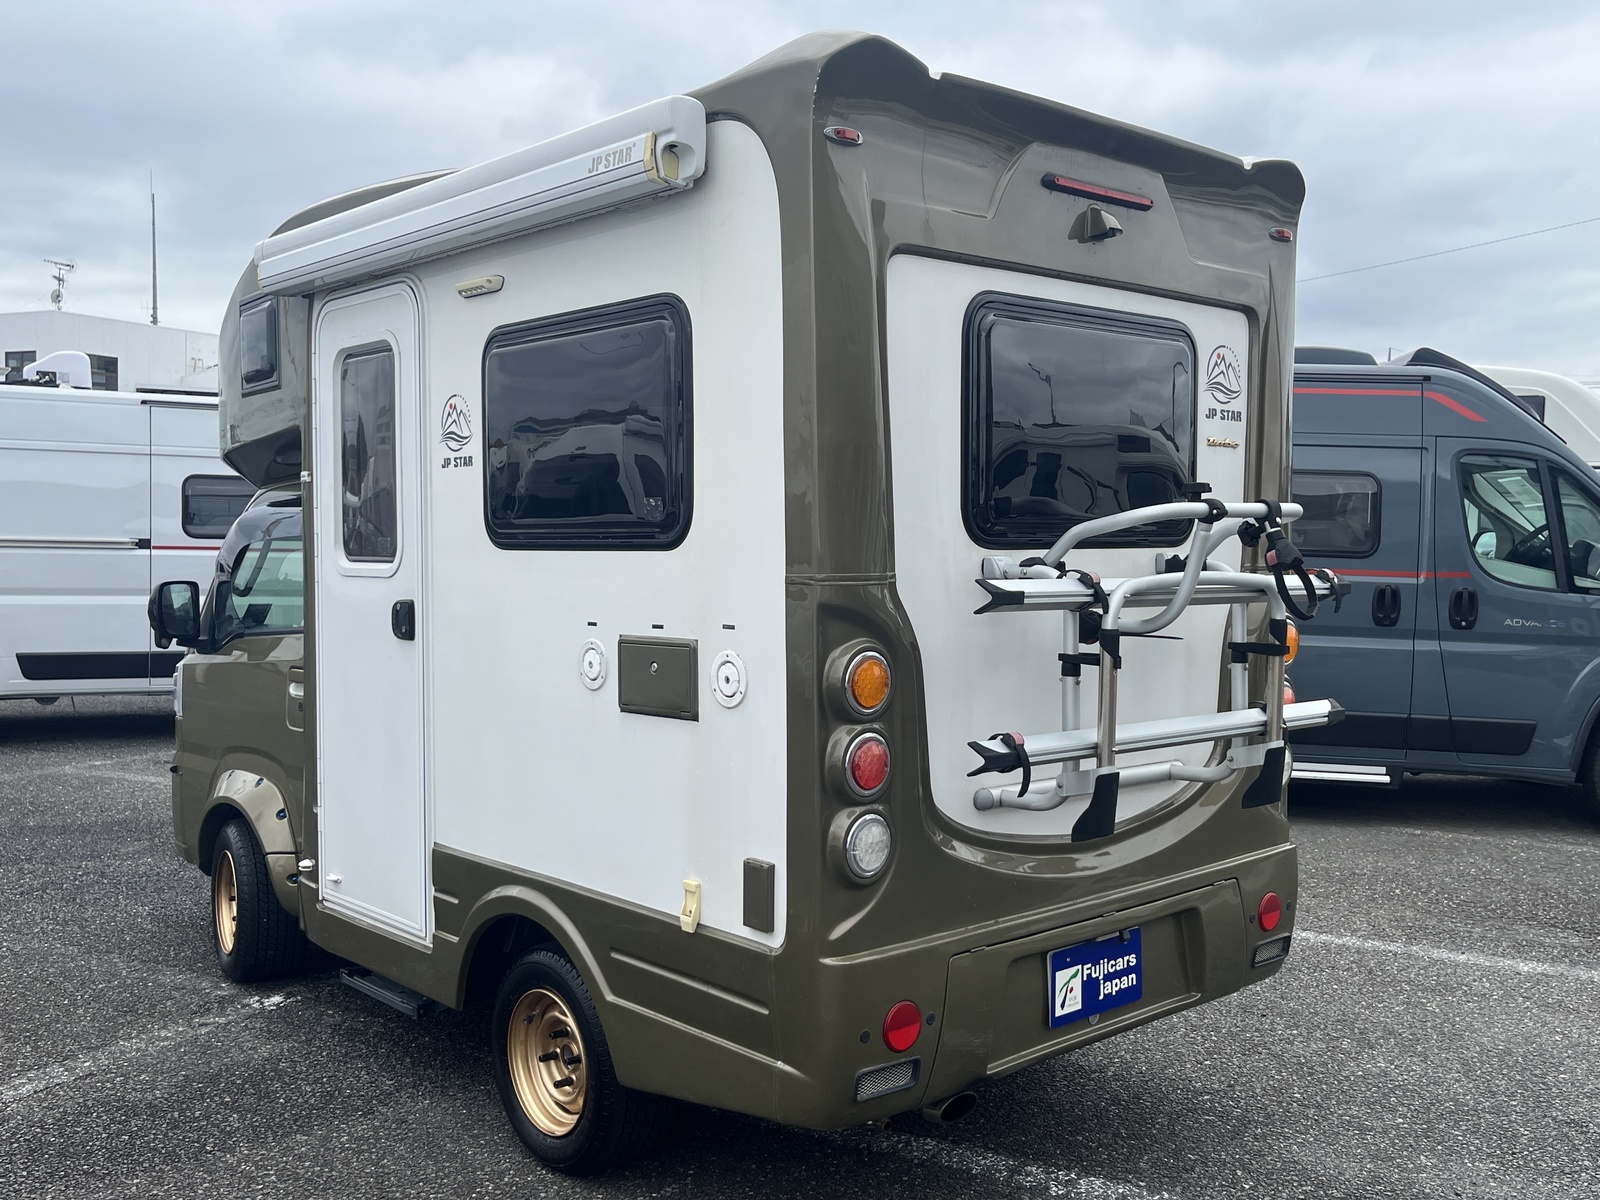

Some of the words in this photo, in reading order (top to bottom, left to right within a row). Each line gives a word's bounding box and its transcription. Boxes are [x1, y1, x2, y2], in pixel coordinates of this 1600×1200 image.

[588, 156, 602, 174] JP
[604, 148, 632, 169] STAR
[1205, 407, 1217, 419] JP
[1219, 409, 1242, 422] STAR
[441, 457, 451, 469] JP
[453, 455, 473, 468] STAR
[1083, 953, 1137, 981] Fujicars
[1099, 973, 1137, 1000] japan
